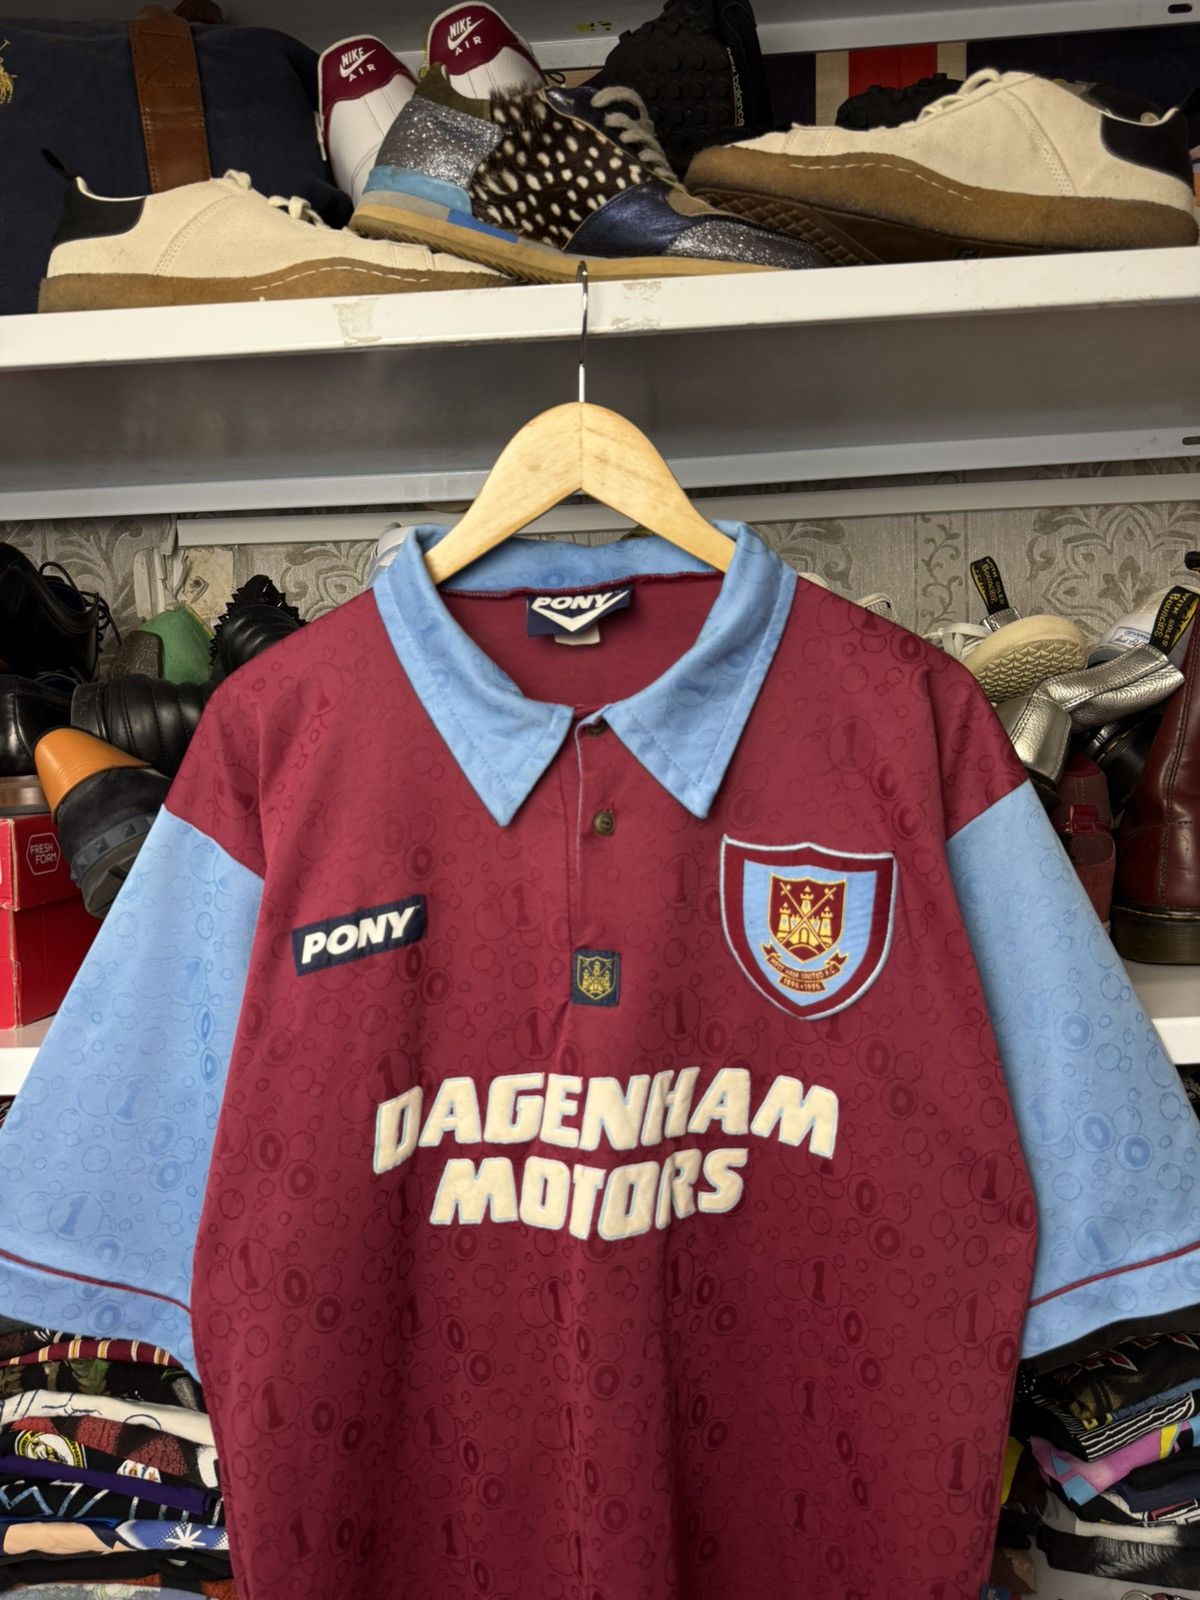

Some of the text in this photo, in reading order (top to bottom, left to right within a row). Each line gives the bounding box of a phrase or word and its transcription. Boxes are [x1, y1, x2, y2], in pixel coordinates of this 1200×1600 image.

[449, 16, 473, 39] NIKE
[455, 35, 482, 56] AIR
[341, 47, 364, 67] NIKE
[349, 63, 377, 82] AIR
[532, 591, 613, 610] PONY
[30, 842, 54, 856] FRESH
[35, 852, 57, 865] FOAM
[302, 906, 416, 965] PONY
[373, 1066, 839, 1175] DAGENHAM
[429, 1147, 749, 1242] MOTORS
